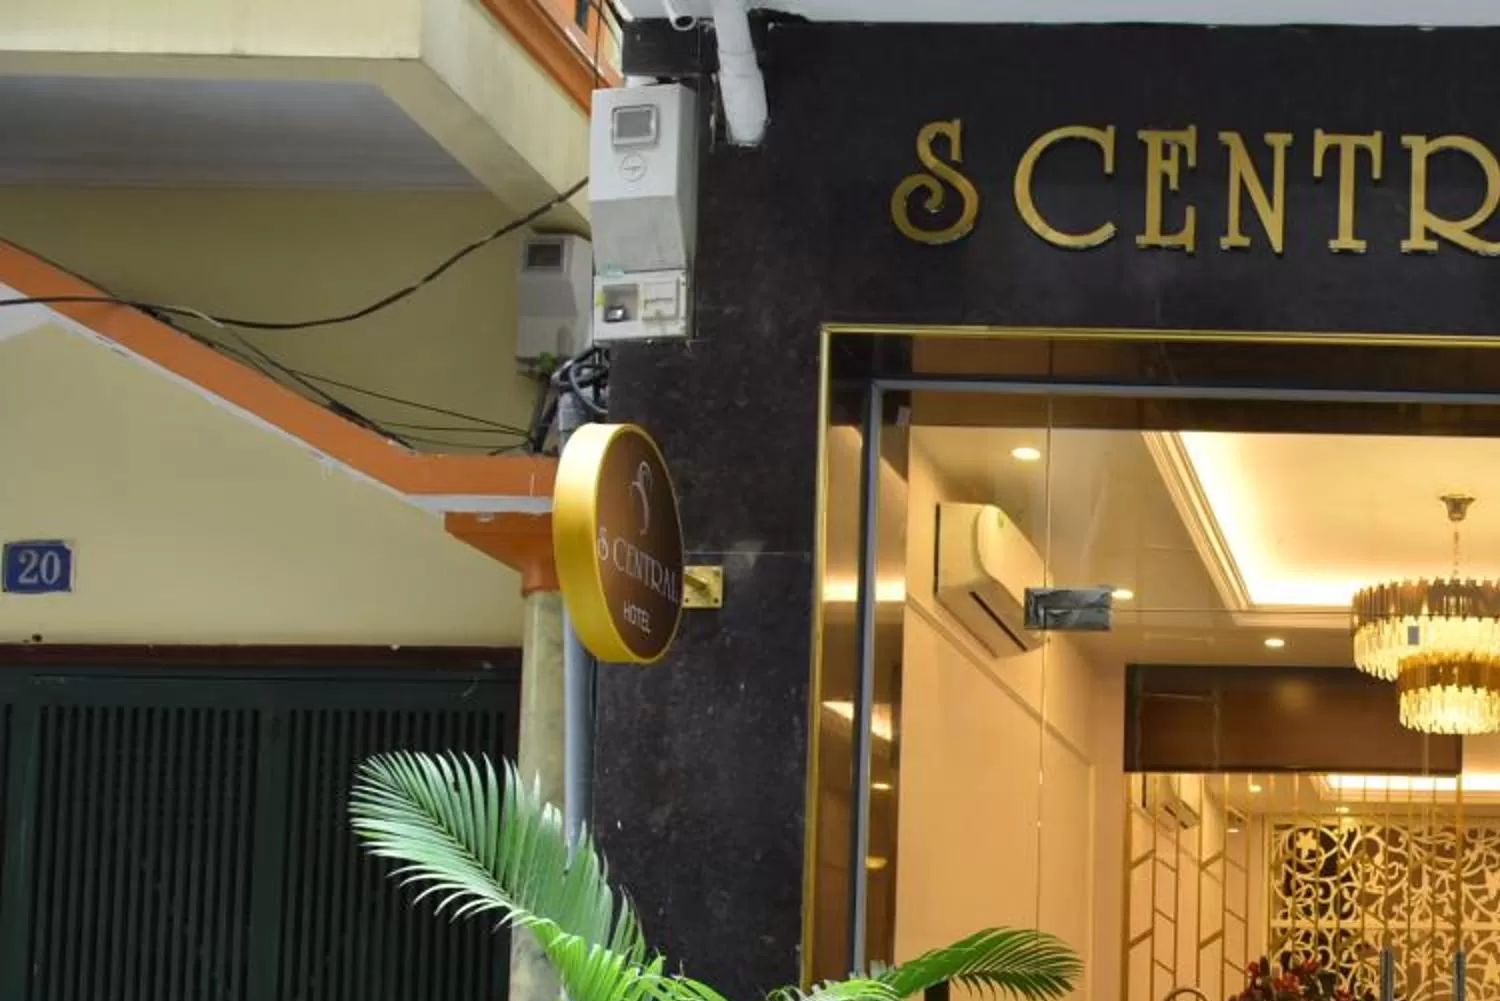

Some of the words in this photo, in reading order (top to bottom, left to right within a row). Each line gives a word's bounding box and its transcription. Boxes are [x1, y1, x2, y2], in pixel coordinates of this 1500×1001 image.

[891, 118, 979, 245] S
[18, 550, 61, 585] 20
[613, 537, 677, 604] CENTRAL
[623, 600, 651, 634] HOTEL
